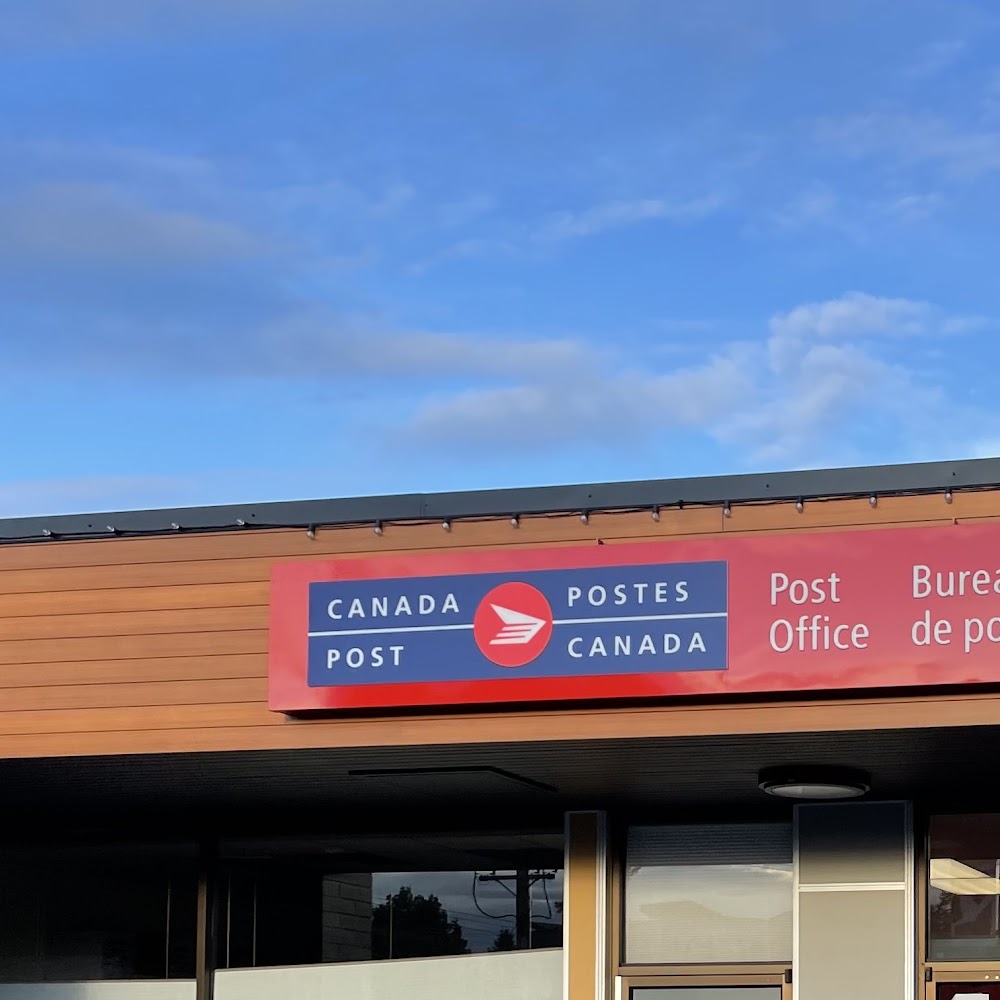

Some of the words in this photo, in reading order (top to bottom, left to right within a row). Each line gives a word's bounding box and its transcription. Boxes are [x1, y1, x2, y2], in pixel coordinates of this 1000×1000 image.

[567, 580, 690, 608] POSTES
[770, 572, 841, 606] Post
[326, 592, 461, 620] CANADA
[769, 614, 870, 652] Office
[911, 609, 952, 646] de
[326, 645, 405, 670] POST
[566, 631, 707, 659] CANADA
